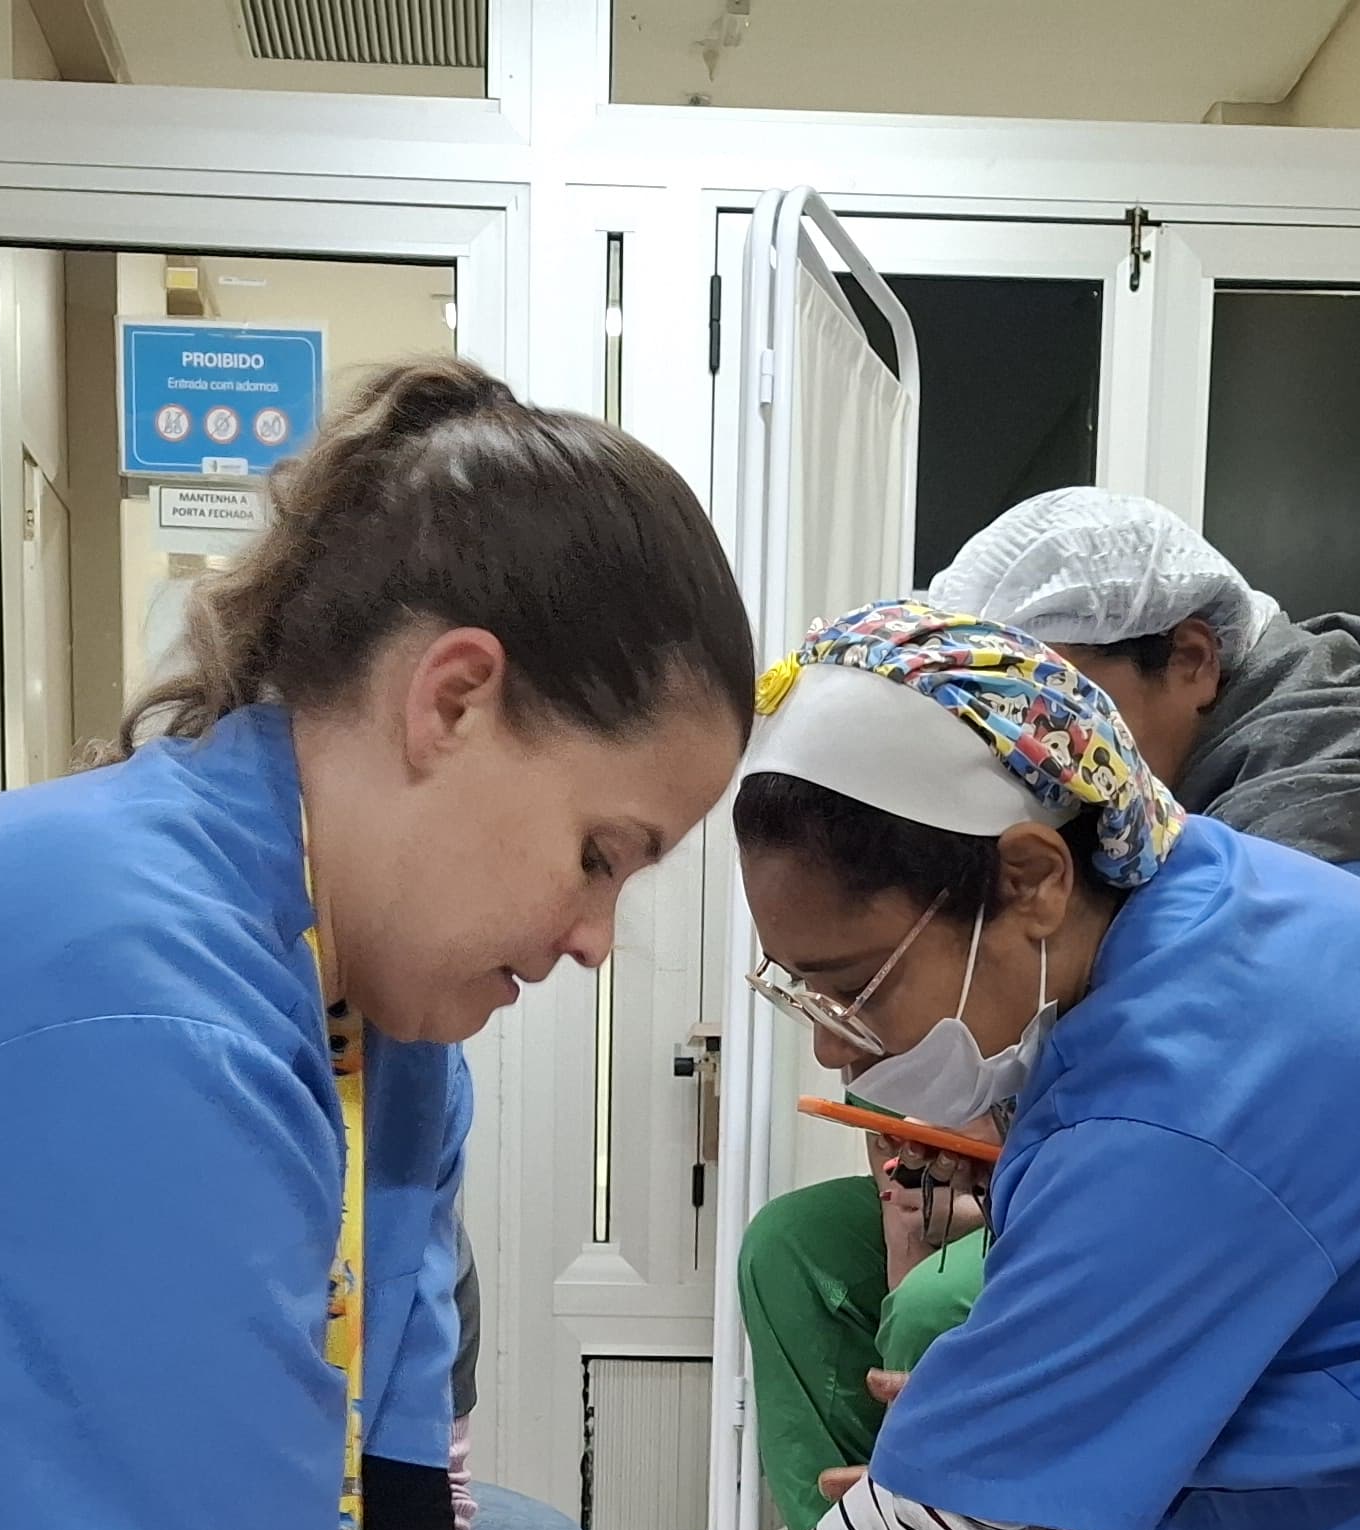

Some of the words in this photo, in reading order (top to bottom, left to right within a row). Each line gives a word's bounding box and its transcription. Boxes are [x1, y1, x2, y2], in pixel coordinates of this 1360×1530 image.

[182, 351, 265, 369] PROIBIDO
[167, 376, 208, 390] Entrada
[210, 381, 234, 391] com
[179, 493, 238, 504] MANTENHA
[172, 507, 206, 518] PORTA
[208, 509, 254, 520] FECHADA
